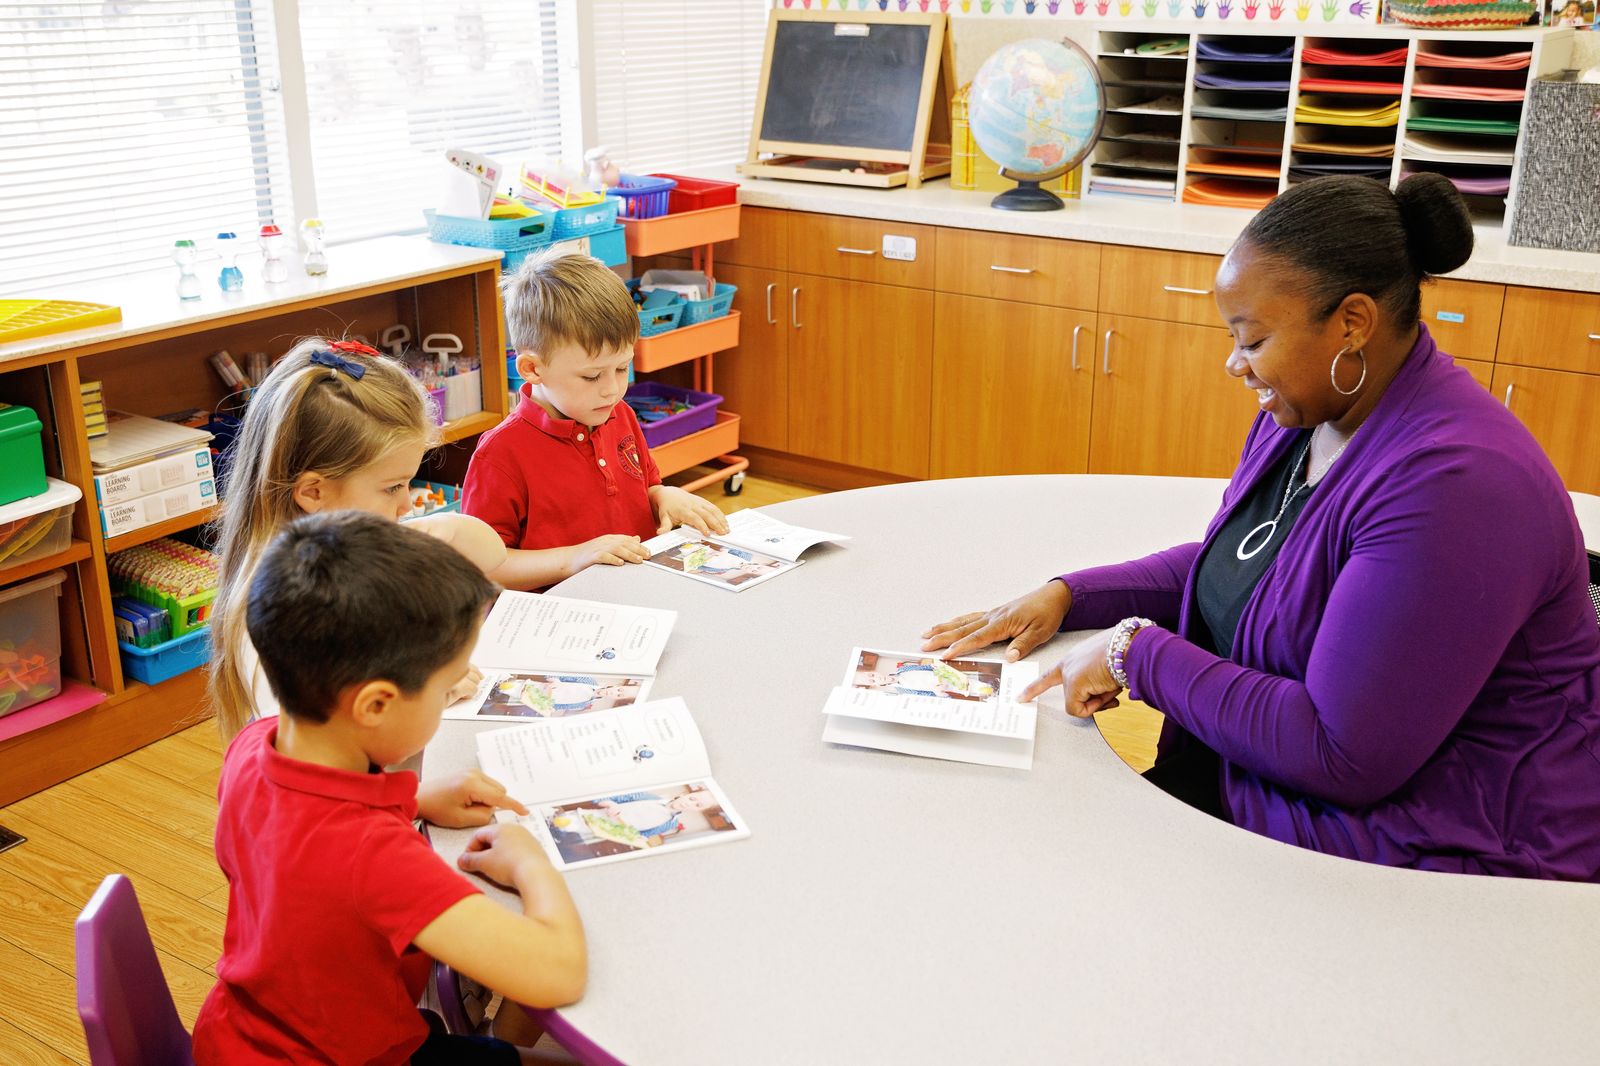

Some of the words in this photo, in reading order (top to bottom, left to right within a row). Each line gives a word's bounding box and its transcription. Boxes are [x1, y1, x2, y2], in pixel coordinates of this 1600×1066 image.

[105, 475, 131, 487] LEARNING
[106, 485, 127, 495] BOARDS
[110, 506, 136, 518] LEARNING
[111, 516, 132, 526] BOARDS
